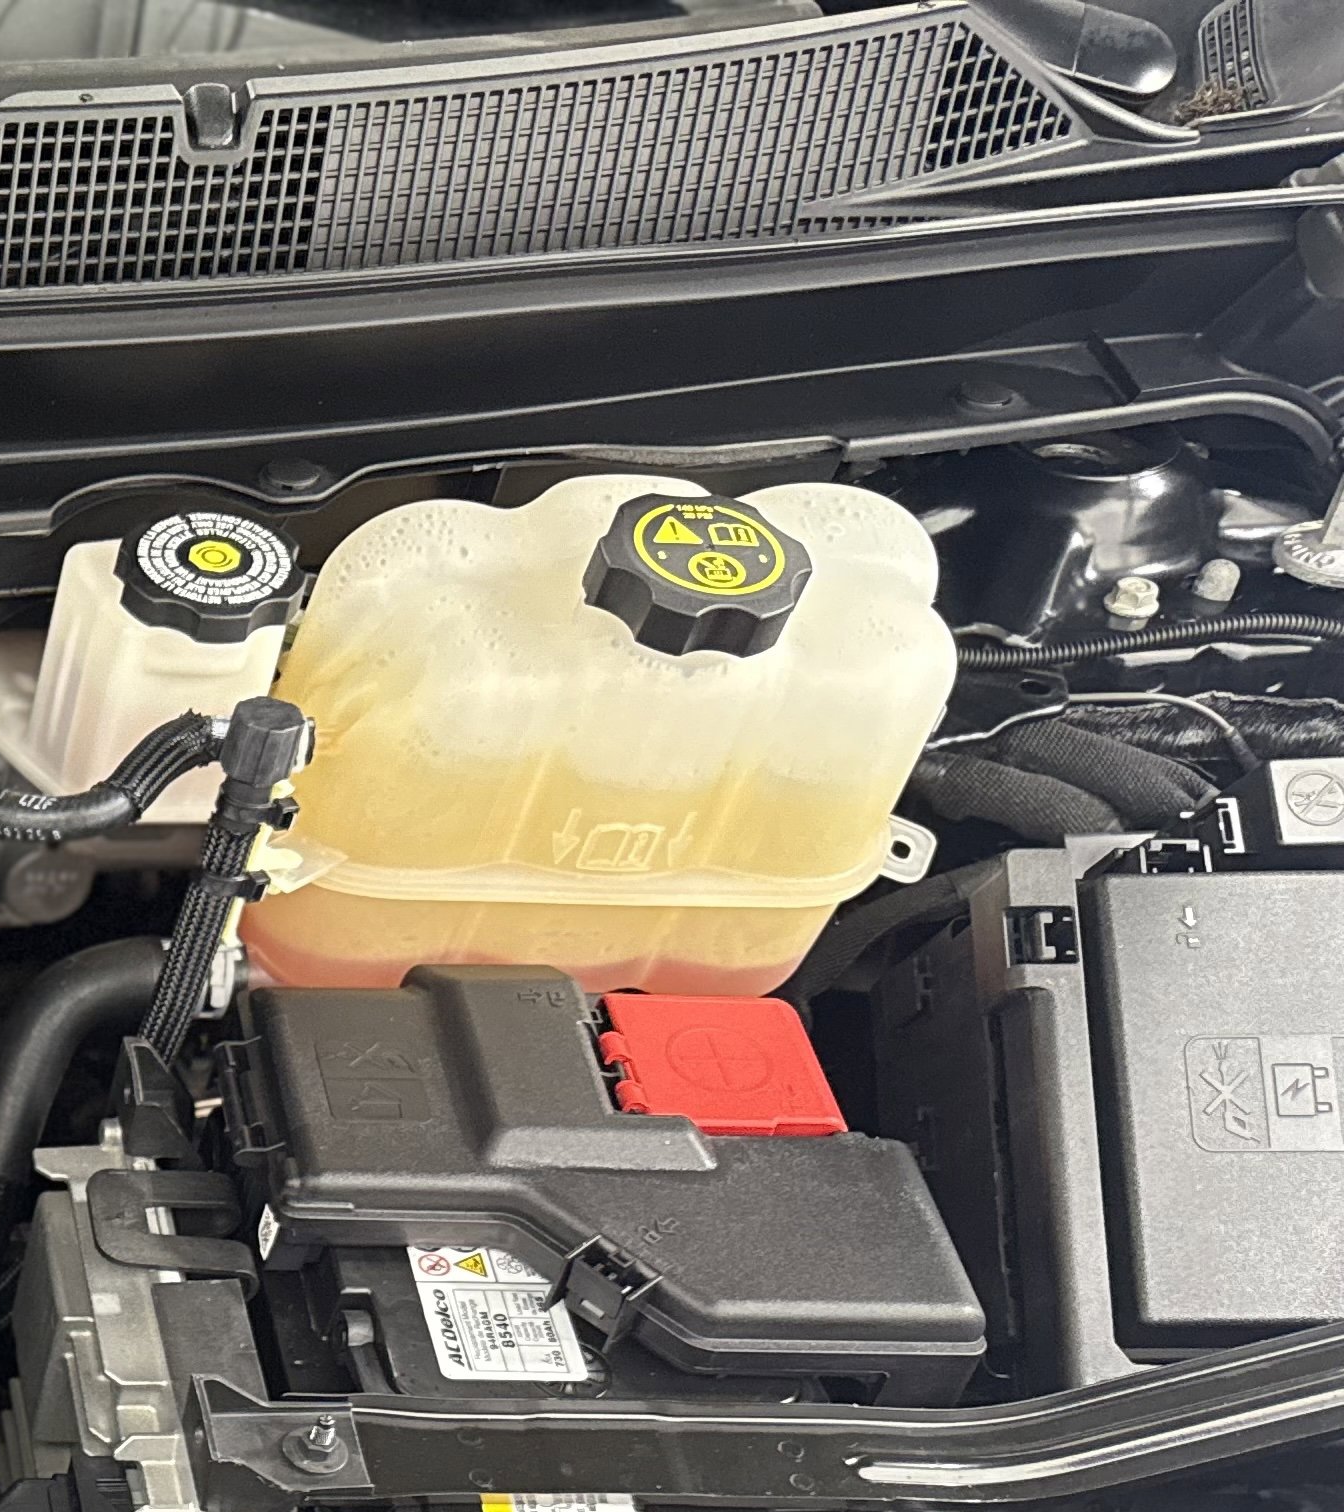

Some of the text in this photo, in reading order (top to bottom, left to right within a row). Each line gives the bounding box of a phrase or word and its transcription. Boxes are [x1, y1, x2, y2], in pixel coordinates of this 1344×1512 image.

[432, 1289, 465, 1366] ACDelco
[491, 1313, 516, 1347] 8540
[550, 1350, 565, 1366] 730
